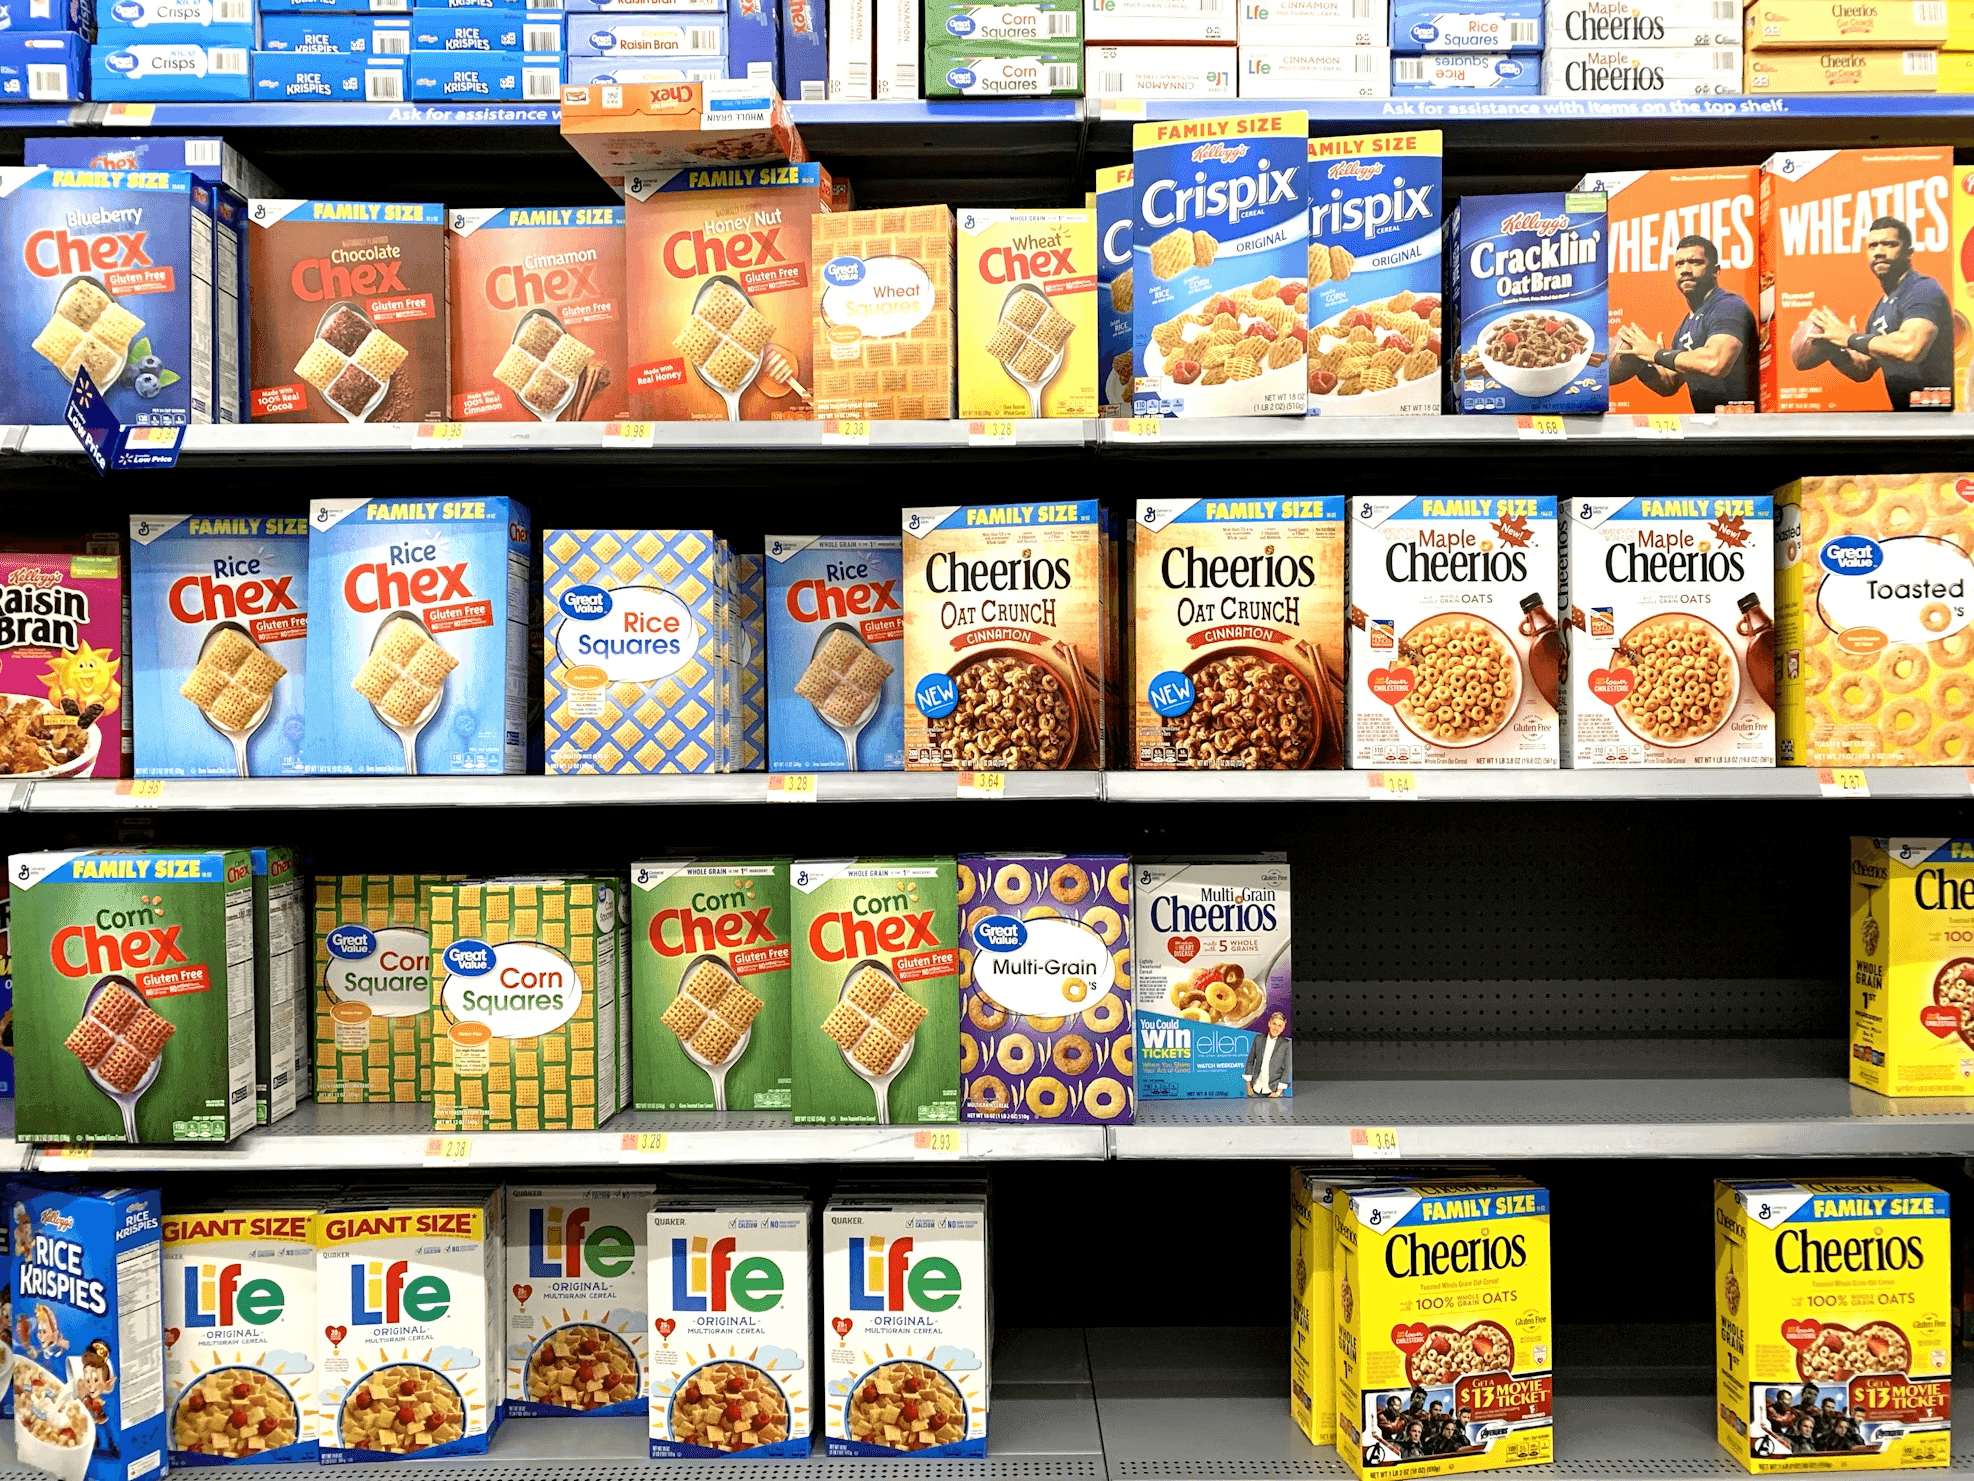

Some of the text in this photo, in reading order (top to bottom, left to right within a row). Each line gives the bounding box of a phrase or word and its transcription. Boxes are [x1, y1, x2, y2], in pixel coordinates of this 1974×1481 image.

[1588, 2, 1629, 15] Maple
[1002, 13, 1036, 27] Corn
[1469, 21, 1498, 32] Rice
[1565, 10, 1665, 42] Cheerios
[981, 26, 1037, 40] Squares
[1444, 35, 1498, 45] Squares
[620, 39, 679, 50] Raisin Bran
[151, 55, 195, 71] Crisps
[1283, 56, 1340, 65] CINNAMON
[299, 73, 324, 85] RICE
[286, 83, 332, 96] KRISPIES
[388, 108, 422, 120] Ask
[425, 108, 452, 120] for
[456, 108, 541, 121] assistance
[1383, 98, 1789, 116] Ask for assistance with items on the top shelf.
[1157, 116, 1282, 141] FAMILY SIZE
[1192, 143, 1248, 163] Kellogg's
[53, 171, 169, 189] FAMILY SIZE
[1141, 157, 1299, 225] Crispix
[67, 207, 143, 227] Blueberry
[705, 209, 782, 235] Honey Nut
[1241, 208, 1265, 218] CEREAL
[1012, 233, 1062, 251] Wheat
[1236, 230, 1287, 252] ORIGINAL
[24, 229, 153, 278] Chex
[331, 245, 400, 263] Chocolate
[524, 246, 597, 270] Cinnamon
[662, 228, 787, 279] Chex
[1470, 230, 1600, 278] Cracklin'
[828, 263, 859, 275] Great
[978, 247, 1077, 285] Chex
[109, 270, 166, 284] Gluten Free
[291, 259, 407, 301] Chex
[484, 262, 601, 311] Chex
[873, 284, 920, 298] Wheat
[846, 301, 920, 317] Squares
[637, 370, 682, 385] Real Honey
[267, 401, 293, 412] Cocoa
[845, 422, 864, 436] 2.38
[993, 422, 1011, 436] 3.28
[1138, 423, 1157, 437] 3.64
[1537, 421, 1558, 434] 3.68
[1657, 420, 1676, 433] 3.74
[366, 501, 485, 522] FAMILY SIZE
[967, 505, 1078, 525] FAMILY SIZE
[1422, 499, 1538, 517] FAMILY SIZE
[1419, 529, 1476, 550] Maple
[389, 543, 436, 566] Rice
[1828, 545, 1873, 560] Great
[214, 556, 261, 580] Rice
[926, 548, 1071, 592] Cheerios
[1161, 545, 1315, 590] Cheerios
[1386, 542, 1528, 582] Cheerios
[1605, 544, 1745, 582] Cheerios
[826, 562, 868, 582] Rice
[343, 561, 473, 613] Chex
[1867, 578, 1964, 599] Toasted
[168, 575, 298, 624] Chex
[565, 591, 603, 606] Great
[786, 579, 901, 623] Chex
[1461, 594, 1493, 604] OATS
[624, 611, 680, 633] Rice
[941, 599, 1057, 628] OAT CRUNCH
[967, 628, 1031, 643] CINNAMON
[1205, 626, 1273, 641] CINNAMON
[578, 634, 681, 659] Squares
[917, 683, 955, 708] NEW
[1514, 724, 1551, 733] Gluten Free
[789, 776, 807, 791] 3.28
[980, 774, 999, 787] 3.64
[72, 859, 201, 879] FAMILY SIZE
[707, 867, 727, 875] GRAIN
[1201, 887, 1276, 902] Multi Grain
[853, 894, 908, 916] Corn
[96, 908, 154, 930] Corn
[1150, 896, 1277, 933] Cheerios
[809, 911, 940, 962] Chex
[979, 924, 1018, 938] Great
[332, 934, 368, 948] Great
[1219, 940, 1227, 952] 5
[50, 925, 189, 978] Chex
[993, 958, 1097, 976] Multi-Grain
[1856, 960, 1883, 976] WHOLE
[500, 968, 563, 989] Corn
[1856, 972, 1882, 990] GRAIN
[463, 991, 563, 1016] Squares
[1141, 1019, 1179, 1029] You Could
[1197, 1031, 1248, 1054] ellen
[1142, 1049, 1191, 1058] TICKETS
[447, 1141, 466, 1157] 2.38
[641, 1133, 661, 1149] 3.28
[931, 1134, 951, 1150] 2.93
[1376, 1133, 1395, 1149] 3.64
[1422, 1194, 1536, 1221] FAMILY SIZE
[125, 1210, 149, 1225] RICE
[654, 1218, 686, 1226] QUAKER
[116, 1218, 158, 1241] KRISPIES
[162, 1219, 246, 1243] GIANT
[325, 1215, 413, 1241] GIANT
[529, 1206, 635, 1279] Life
[1775, 1228, 1924, 1274] Cheerios
[35, 1235, 82, 1276] RICE
[1385, 1232, 1527, 1279] Cheerios
[671, 1236, 785, 1312] Life
[20, 1265, 107, 1315] KRISPIES
[184, 1263, 284, 1328] Life
[351, 1260, 451, 1326] Life
[1483, 1290, 1517, 1303] OATS
[1416, 1297, 1454, 1311] 100%
[1497, 1380, 1542, 1396] MOVIE
[1497, 1390, 1548, 1407] TICKET
